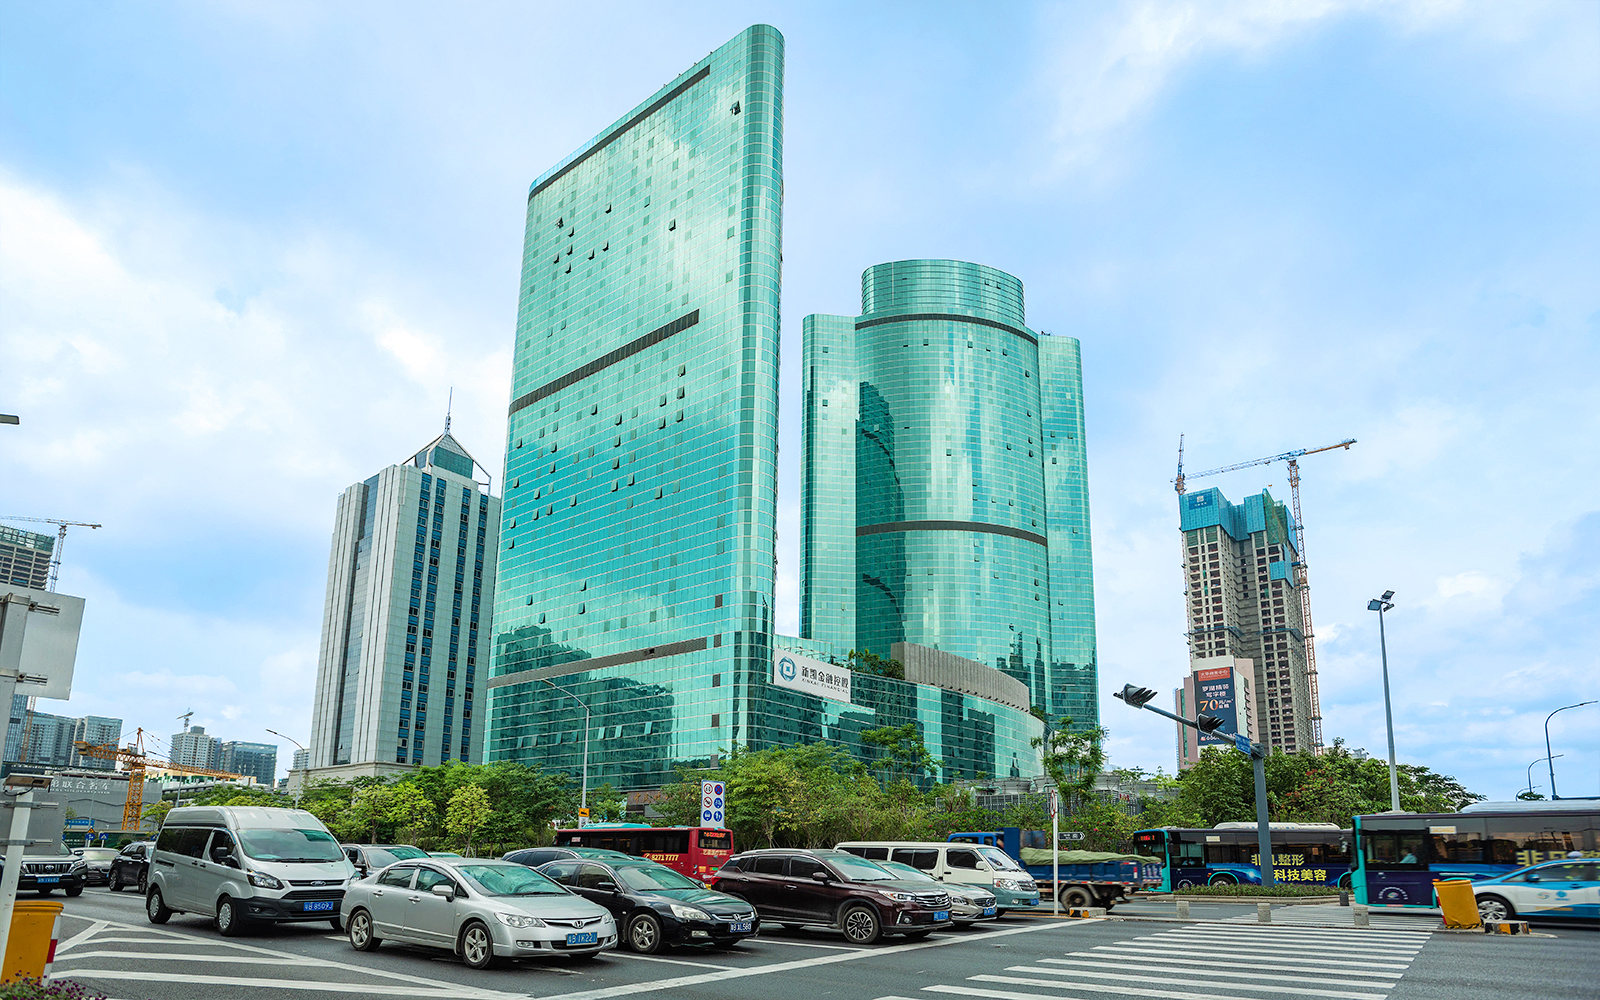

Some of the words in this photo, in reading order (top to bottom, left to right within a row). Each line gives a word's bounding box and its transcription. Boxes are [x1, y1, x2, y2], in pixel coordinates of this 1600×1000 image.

[801, 666, 849, 689] 新凯金融控股
[1200, 699, 1218, 711] 70
[1273, 868, 1327, 882] 科技美容
